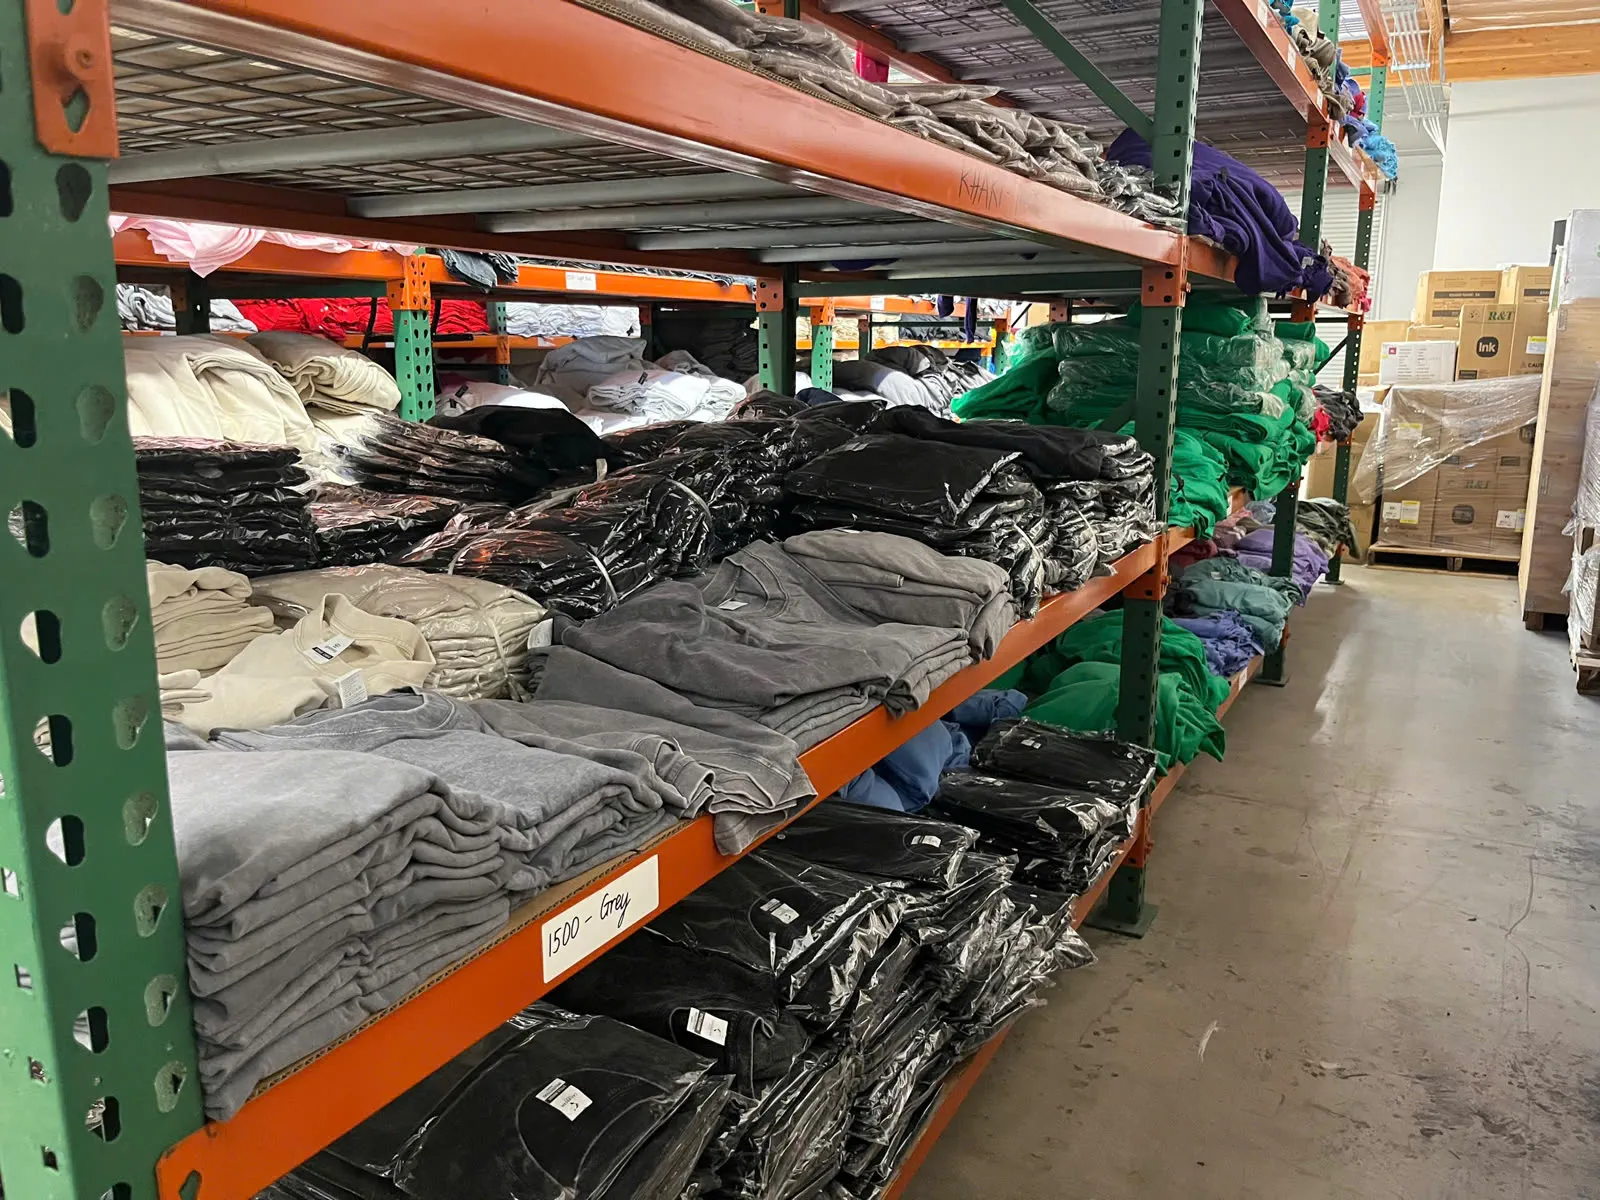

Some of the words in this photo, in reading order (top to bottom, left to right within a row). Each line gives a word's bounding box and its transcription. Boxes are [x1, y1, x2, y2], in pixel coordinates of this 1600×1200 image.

[1478, 342, 1496, 353] Ink
[548, 916, 580, 958] 1500
[600, 891, 631, 929] Grey
